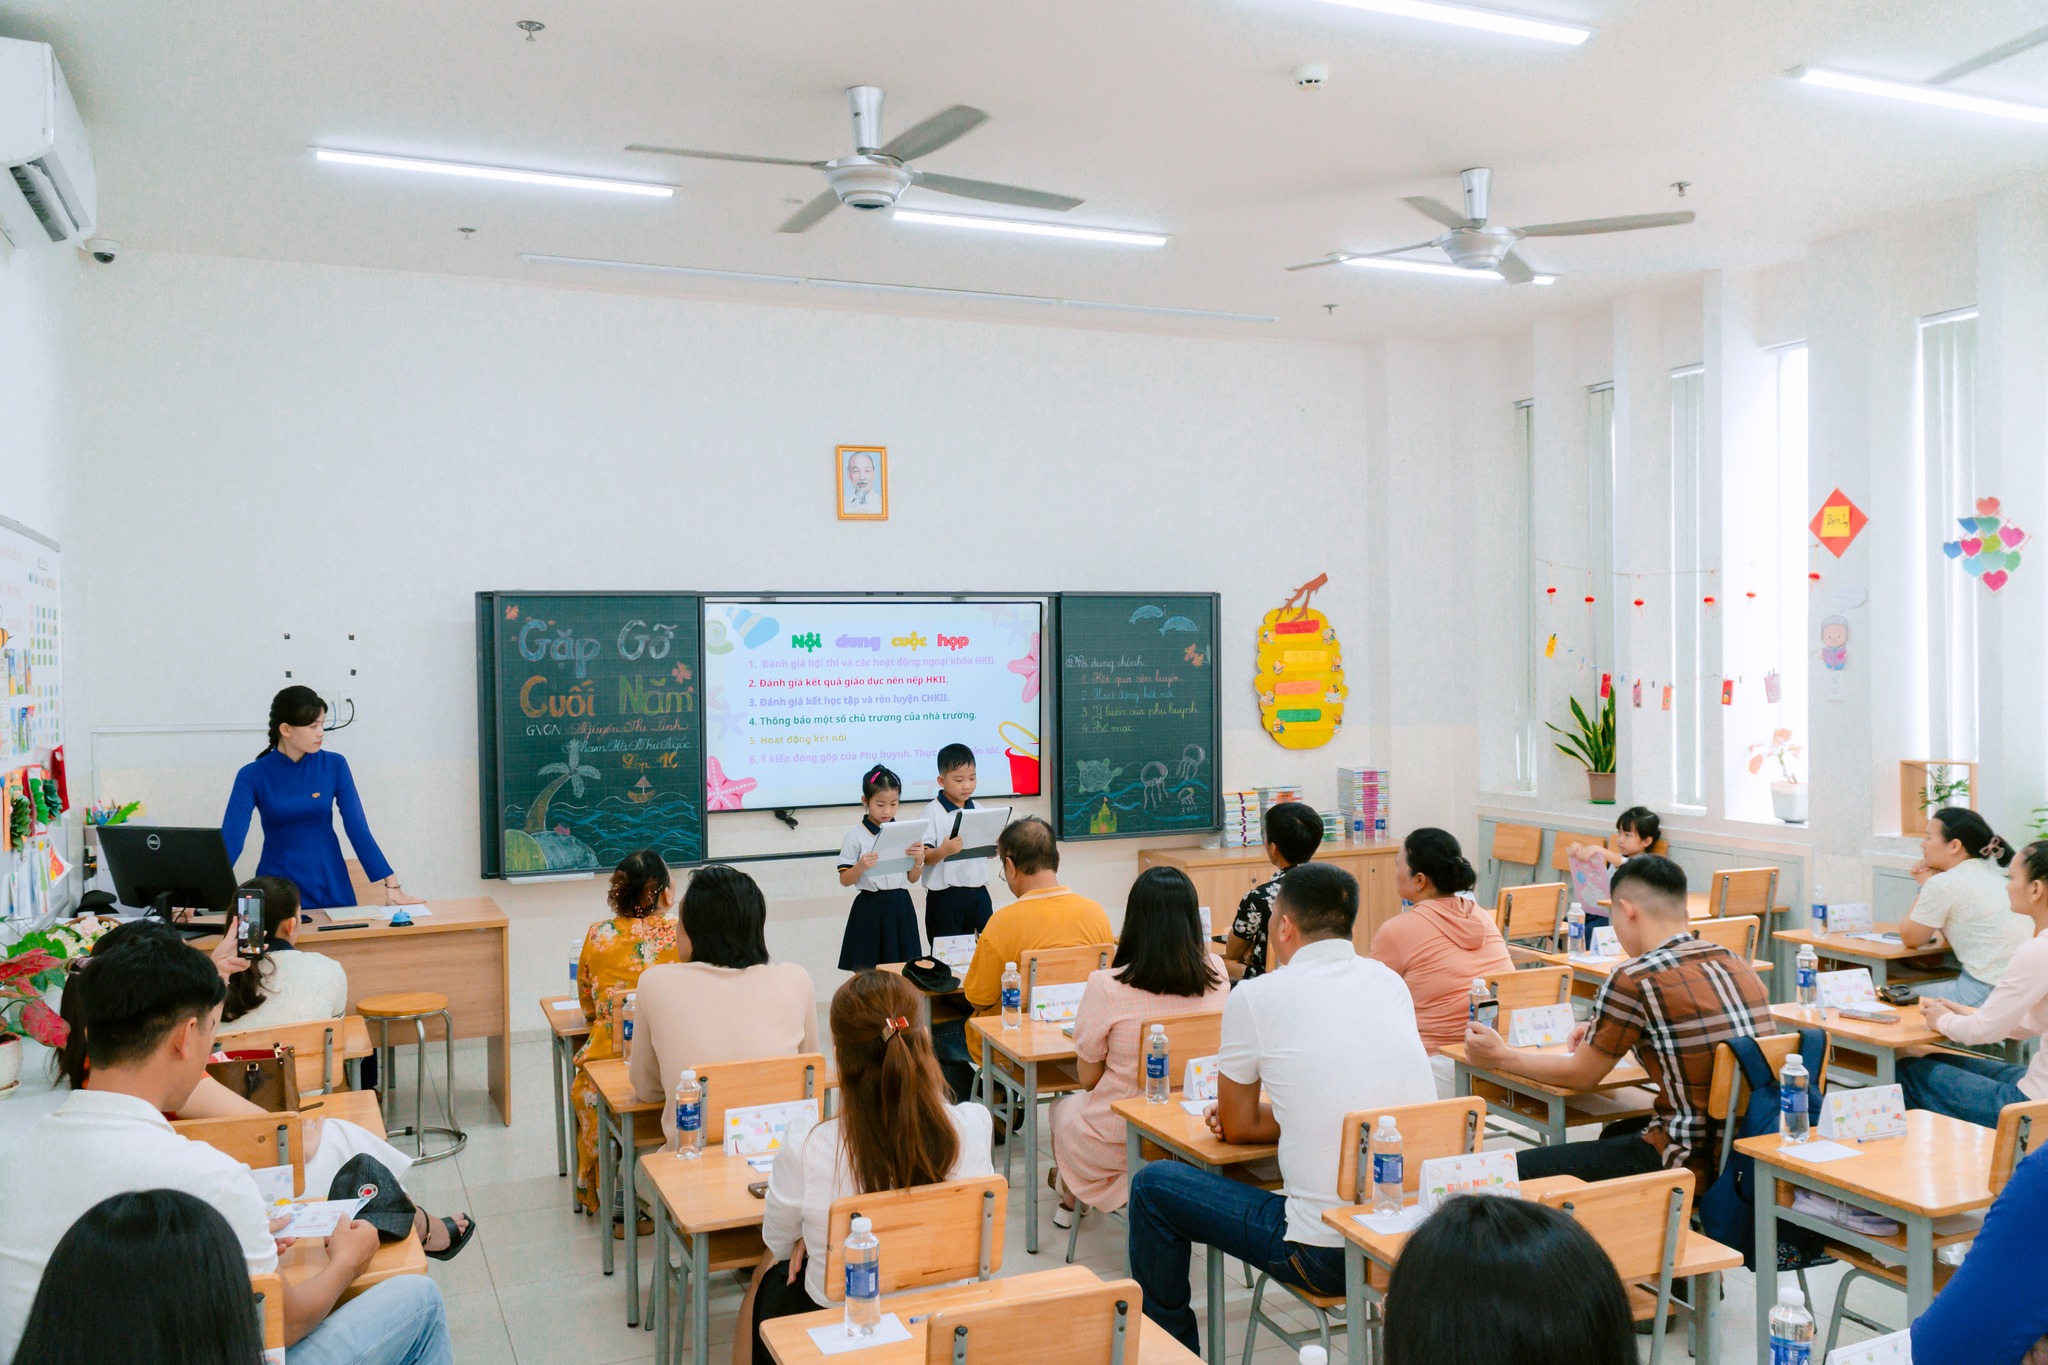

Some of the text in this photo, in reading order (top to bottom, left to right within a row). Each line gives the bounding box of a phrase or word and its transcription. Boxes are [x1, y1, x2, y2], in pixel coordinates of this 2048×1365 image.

[518, 619, 600, 679] Gặp
[791, 631, 970, 653] Nội dung cuộc họp
[748, 656, 997, 670] 1. Đánh giá hội thi và các hoạt động ngoại khóa HKII.
[748, 679, 757, 688] 2.
[759, 679, 786, 688] Đánh
[788, 678, 803, 689] giá
[805, 677, 821, 687] kết
[823, 677, 841, 688] quả
[844, 677, 865, 688] giáo
[867, 676, 884, 687] dục
[926, 675, 949, 684] HKII.
[520, 675, 693, 718] Cuối Năm
[748, 693, 950, 708] 3. Đánh giá kết học tập và rèn luyện CHKII.
[748, 711, 977, 727] 4. Thông báo một số chủ trương của nhà trường.
[749, 736, 758, 745] 5.
[760, 736, 784, 745] Hoạt
[786, 735, 811, 745] động
[749, 756, 758, 765] 6.
[769, 754, 791, 764] kiến
[793, 753, 818, 764] đóng
[820, 753, 838, 763] góp
[840, 751, 857, 761] của
[859, 751, 878, 762] Phụ
[880, 750, 912, 761] huynh.
[914, 749, 937, 758] Thực
